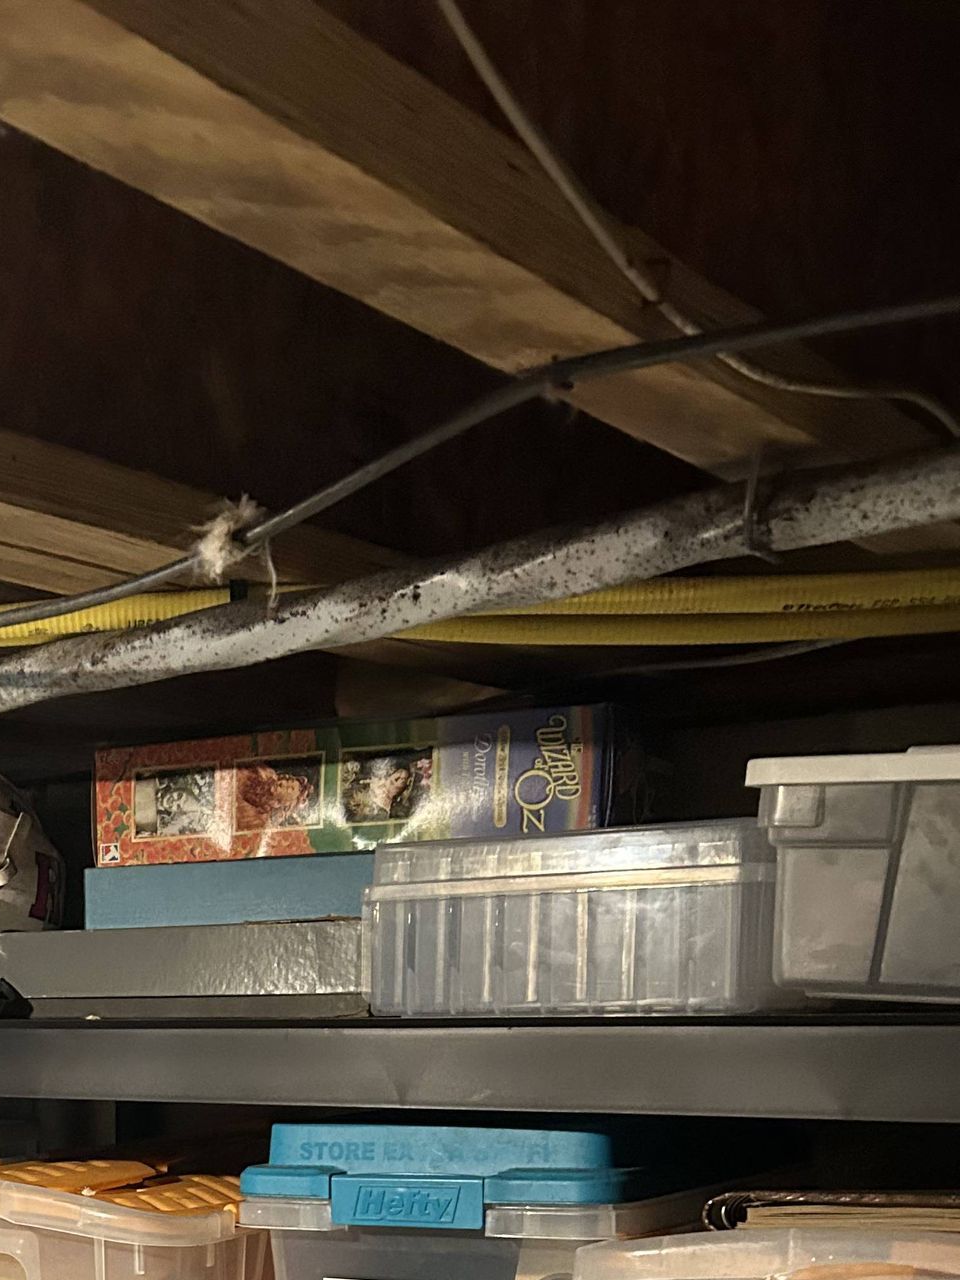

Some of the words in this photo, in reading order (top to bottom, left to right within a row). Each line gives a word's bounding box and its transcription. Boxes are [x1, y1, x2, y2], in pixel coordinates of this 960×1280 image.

[536, 714, 582, 800] WIZARD
[298, 1141, 376, 1161] STORE
[359, 1188, 452, 1221] Hefty
